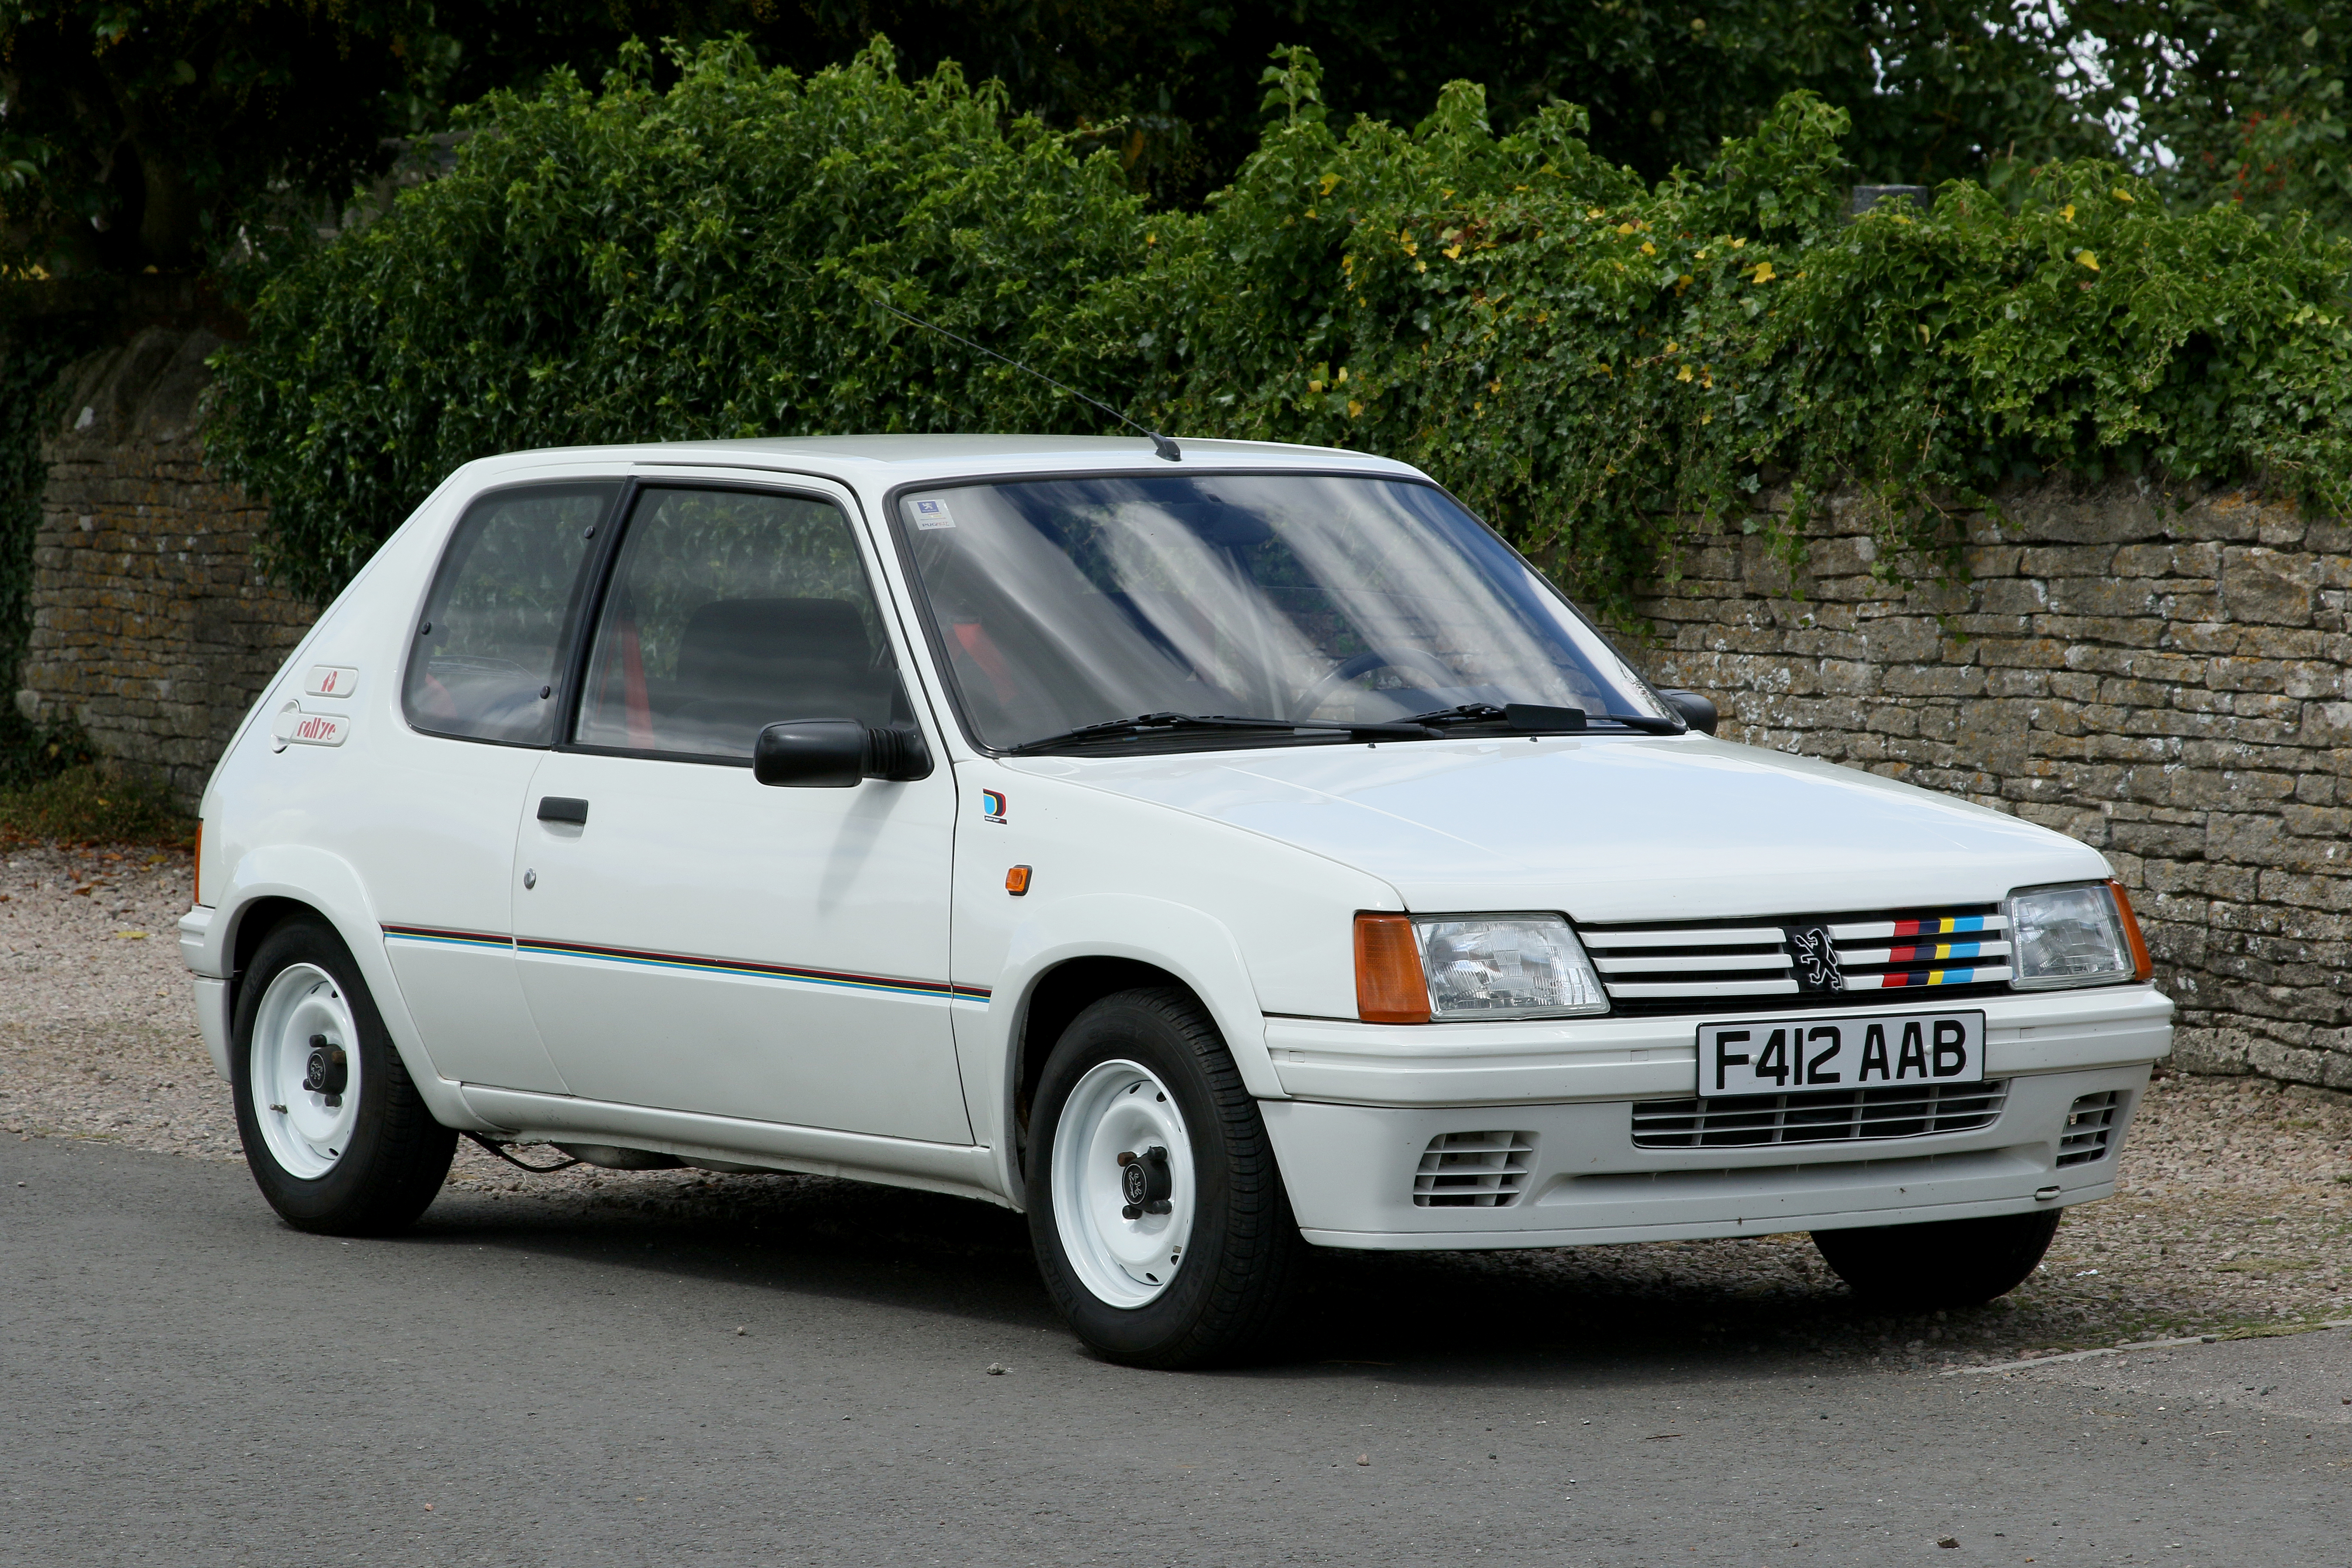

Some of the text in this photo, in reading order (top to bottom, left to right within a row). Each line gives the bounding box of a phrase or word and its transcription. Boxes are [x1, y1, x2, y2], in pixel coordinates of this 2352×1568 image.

[1087, 1022, 1144, 1040] EEGY
[1716, 1020, 1967, 1090] F412 AAB
